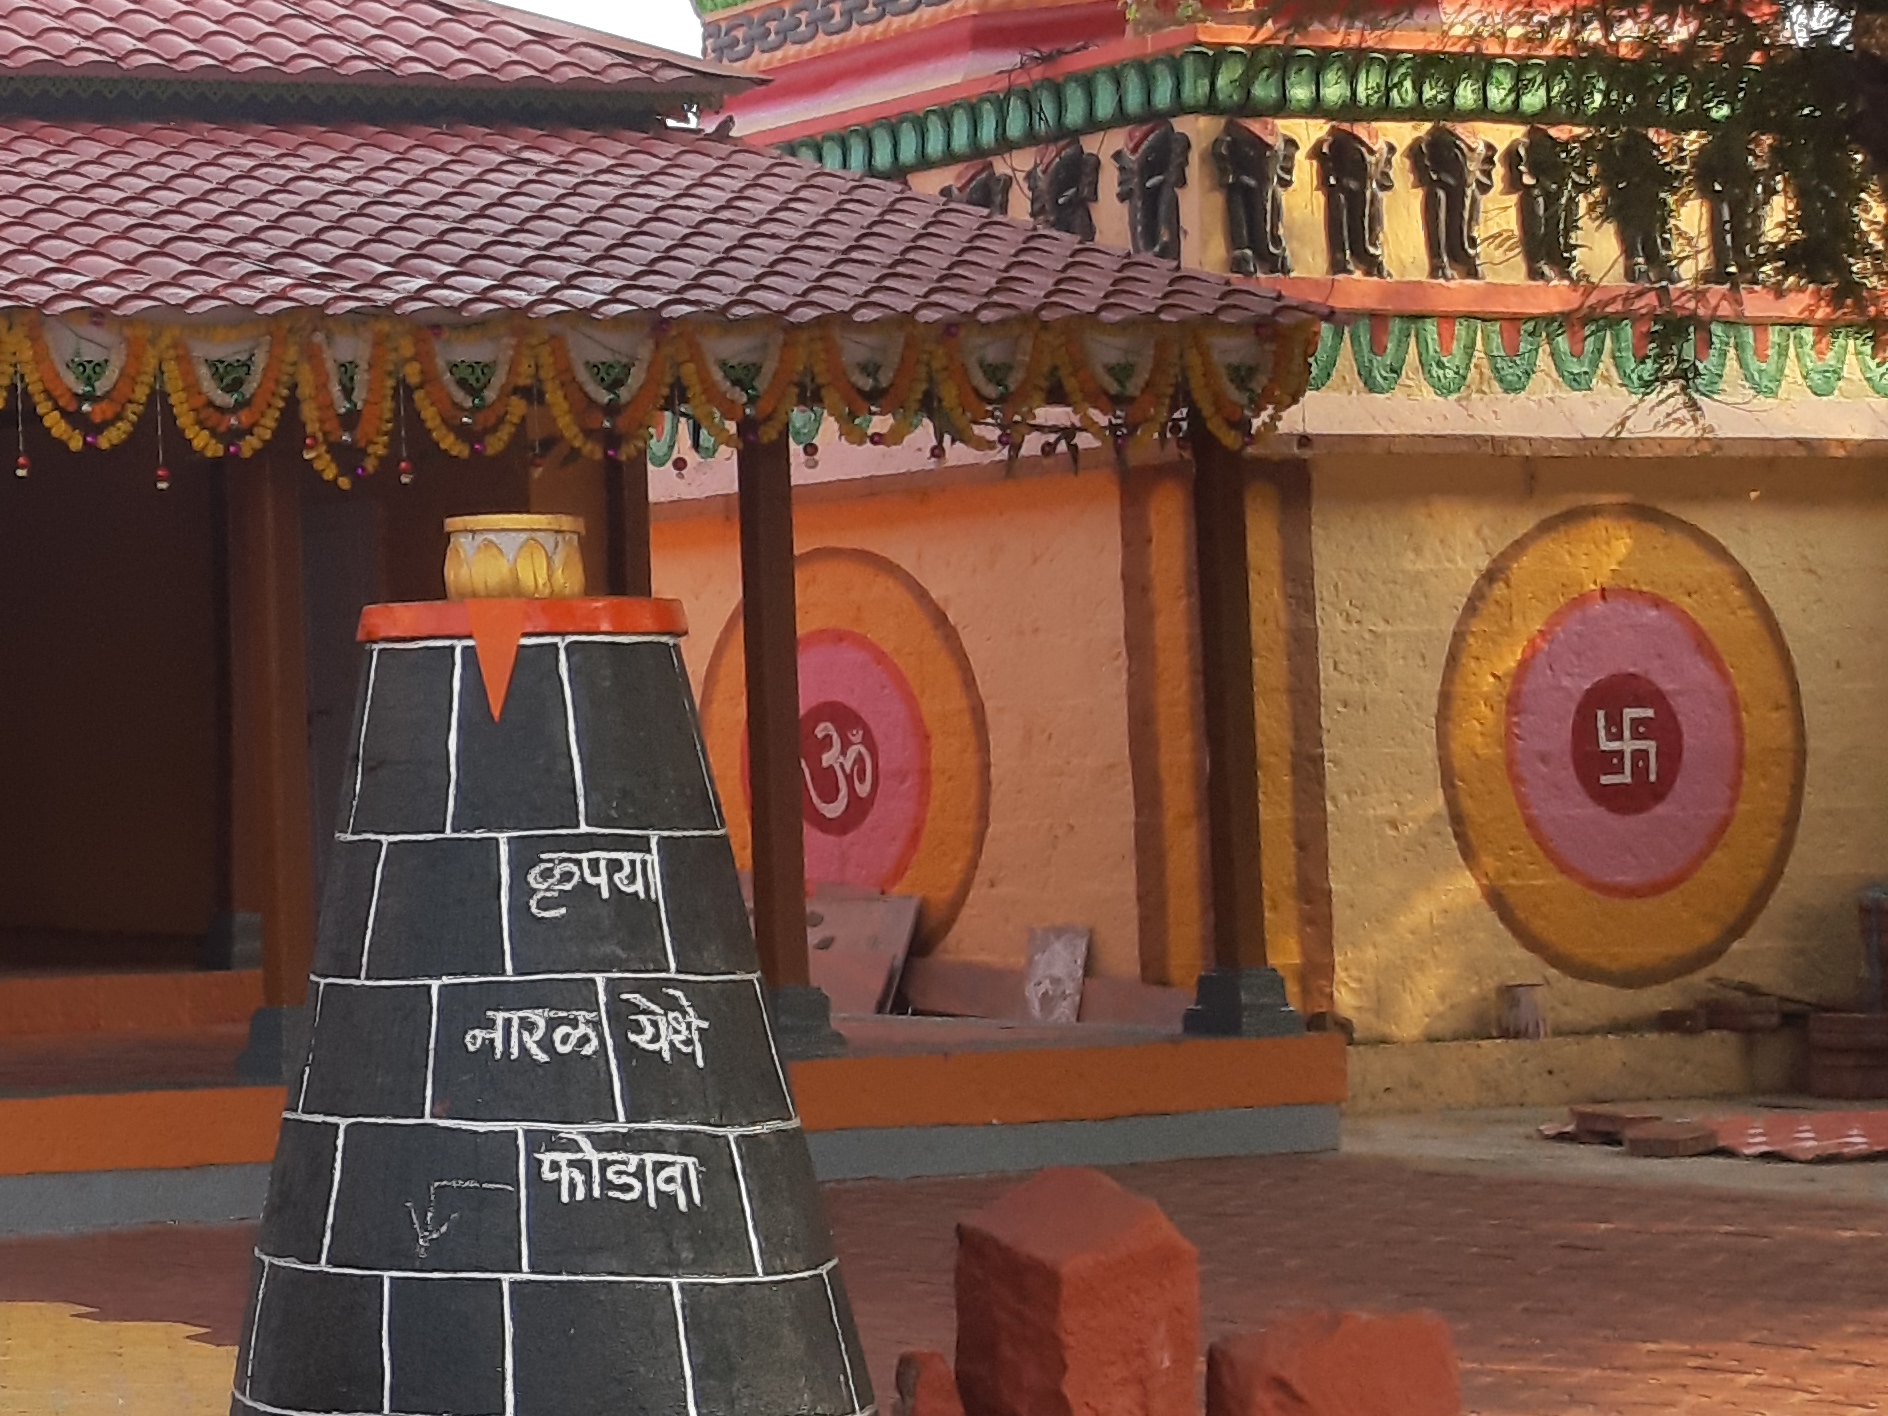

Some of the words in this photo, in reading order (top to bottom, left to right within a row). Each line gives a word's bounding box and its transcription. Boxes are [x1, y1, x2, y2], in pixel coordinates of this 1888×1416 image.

[526, 851, 658, 917] कृपया
[463, 1006, 602, 1066] नारळ
[621, 988, 710, 1070] येथे
[533, 1130, 702, 1213] फोडावा
